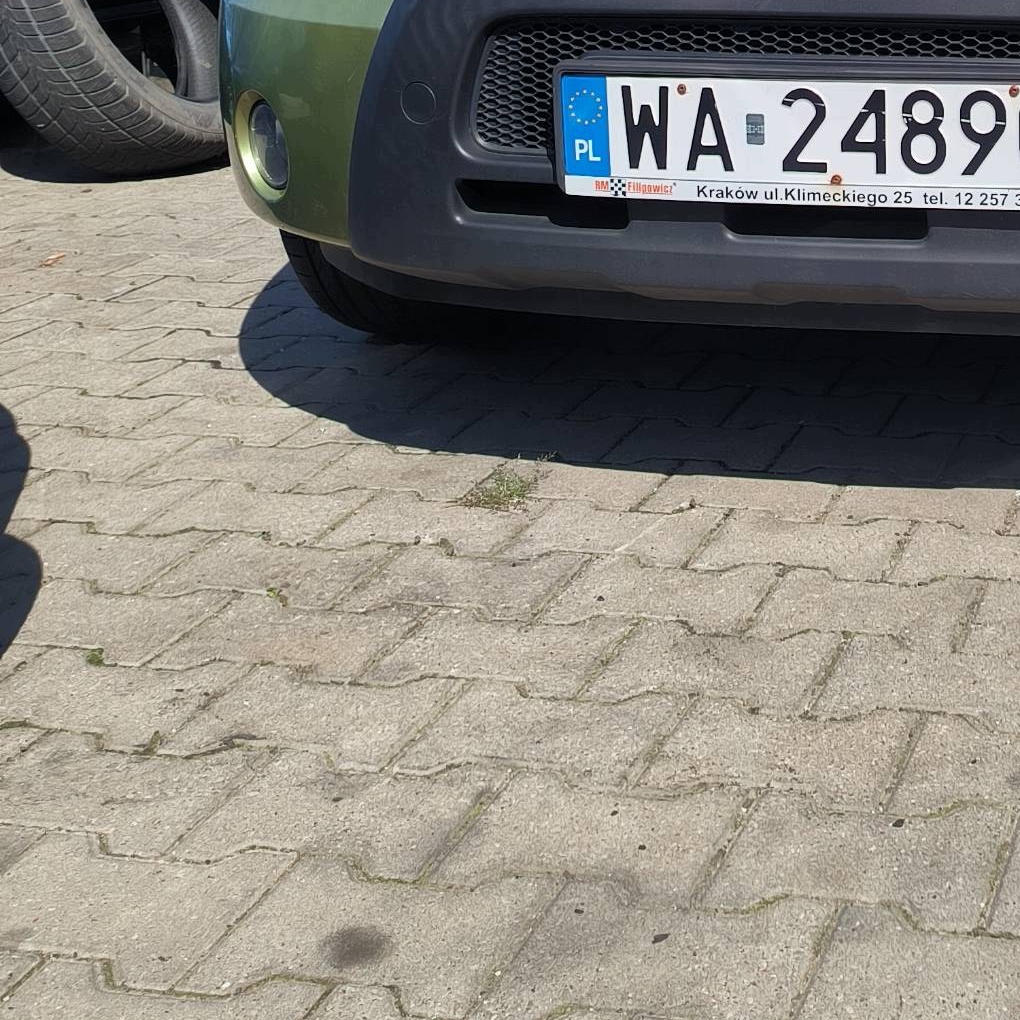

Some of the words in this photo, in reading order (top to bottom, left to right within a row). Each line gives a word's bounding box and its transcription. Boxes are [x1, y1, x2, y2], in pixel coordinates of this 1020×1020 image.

[621, 85, 735, 172] WA
[574, 139, 601, 162] PL
[594, 180, 610, 192] RM
[627, 181, 674, 195] Filipowicz
[696, 185, 758, 201] Kraków
[893, 191, 913, 204] 25
[923, 192, 948, 205] tel.
[955, 192, 973, 206] 12
[979, 193, 1009, 206] 257
